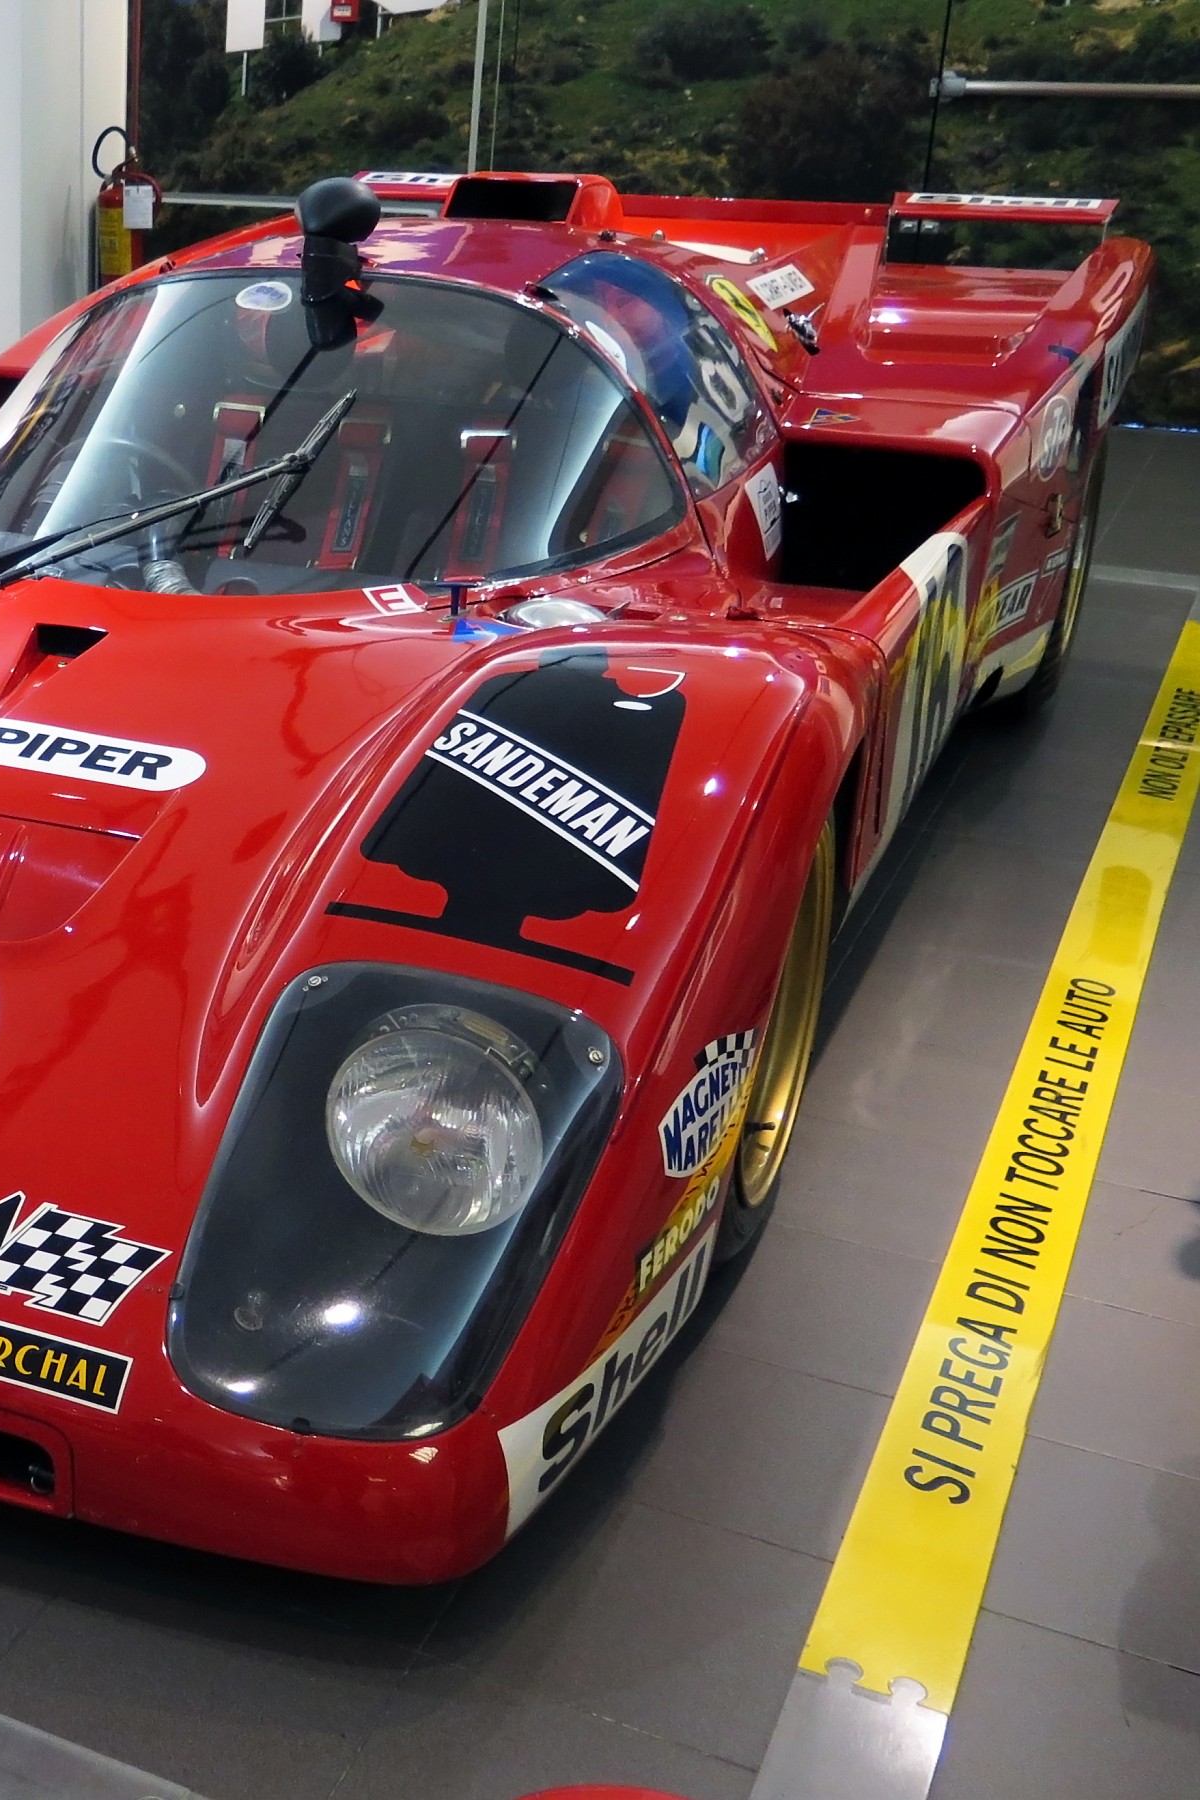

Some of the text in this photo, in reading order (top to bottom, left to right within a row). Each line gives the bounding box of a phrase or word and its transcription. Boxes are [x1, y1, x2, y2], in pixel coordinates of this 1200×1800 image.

[433, 721, 650, 858] SANDEMAN
[1138, 768, 1182, 801] NON
[639, 1175, 721, 1293] FERODO
[903, 977, 1118, 1506] SI PREGA DI NON TOCCARE LE AUTO
[538, 1242, 706, 1493] Shell
